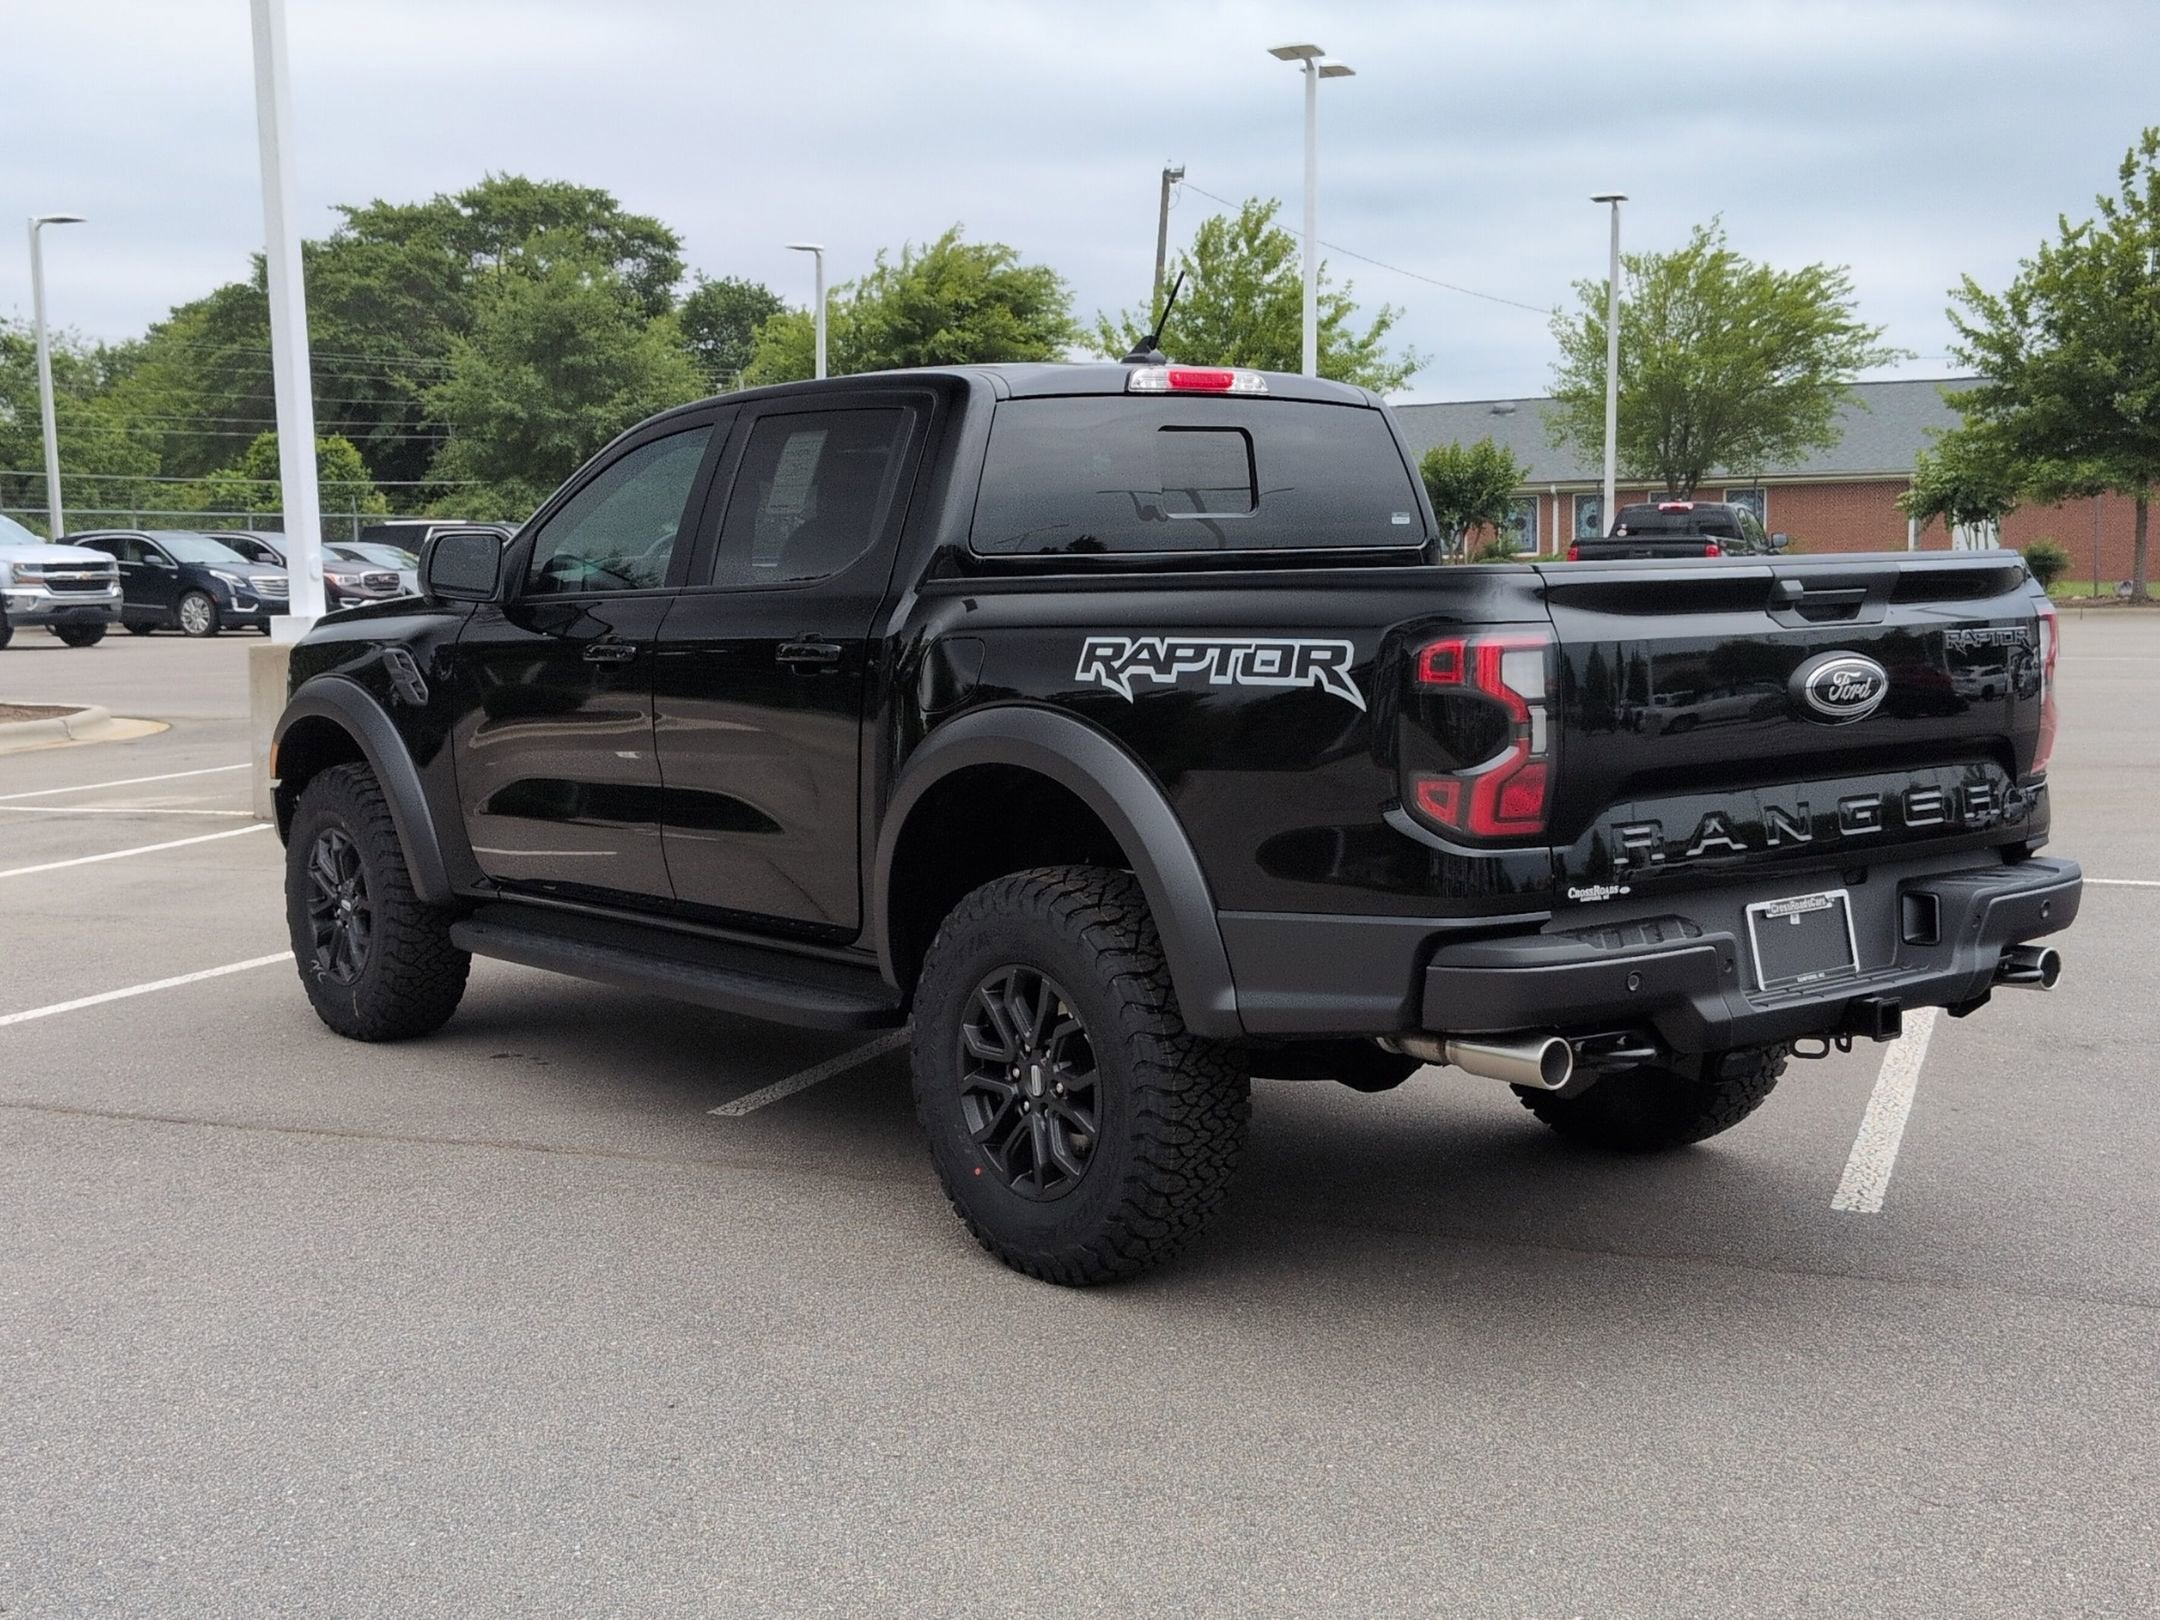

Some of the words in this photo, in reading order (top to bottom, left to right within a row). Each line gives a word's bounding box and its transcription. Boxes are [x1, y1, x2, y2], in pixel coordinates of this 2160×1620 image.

[1943, 627, 2031, 656] RAPTOR
[1075, 636, 1367, 713] RAPTOR
[1828, 670, 1872, 701] Ford
[1610, 783, 2000, 865] RANGER
